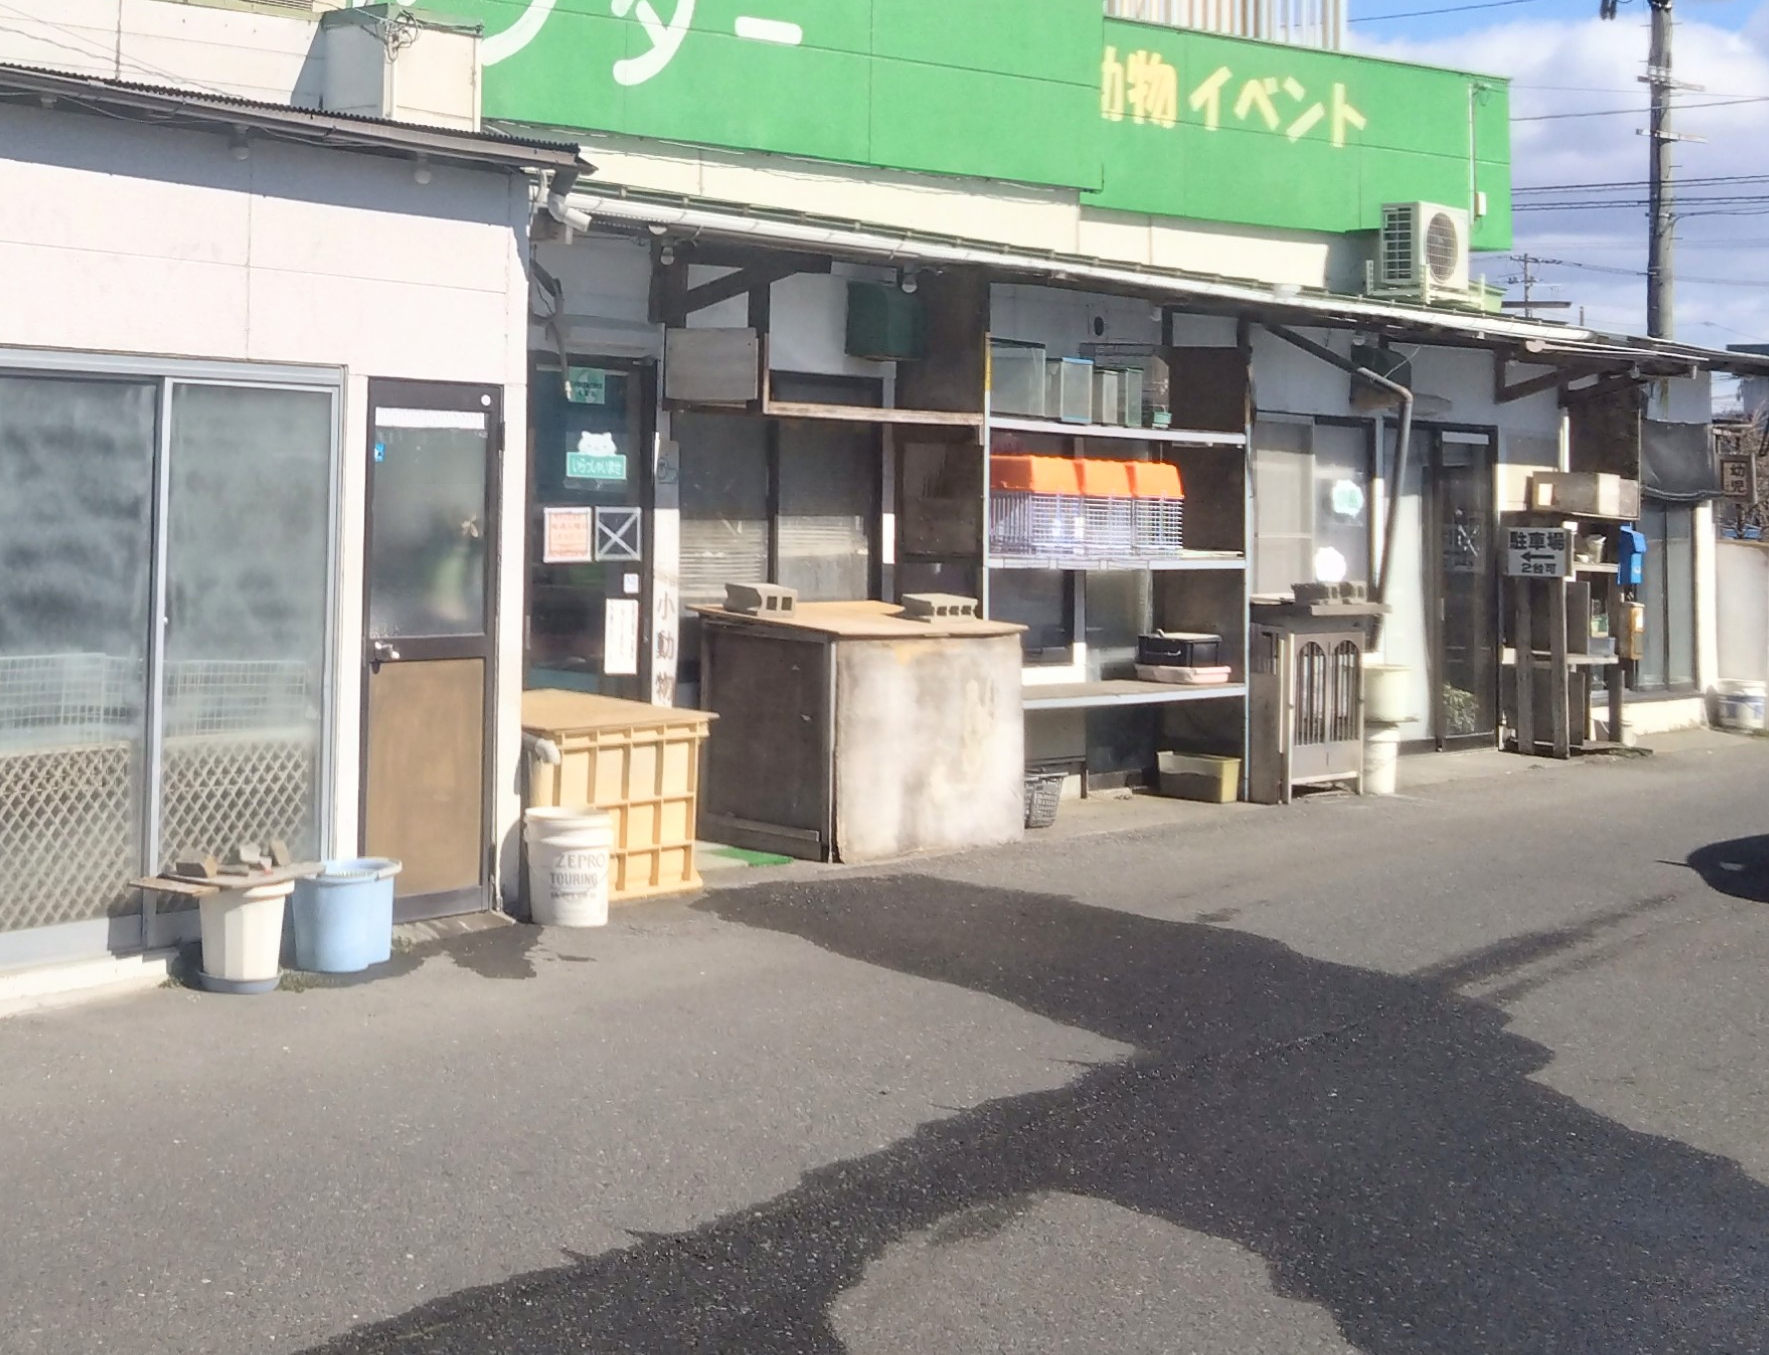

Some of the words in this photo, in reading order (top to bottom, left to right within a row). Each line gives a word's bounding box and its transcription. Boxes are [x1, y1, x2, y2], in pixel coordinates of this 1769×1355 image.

[1510, 531, 1565, 550] 駐車場
[1521, 562, 1557, 574] 2台可
[656, 591, 675, 702] 小動物
[556, 853, 606, 869] ZEPRO
[550, 872, 598, 886] TOURING
